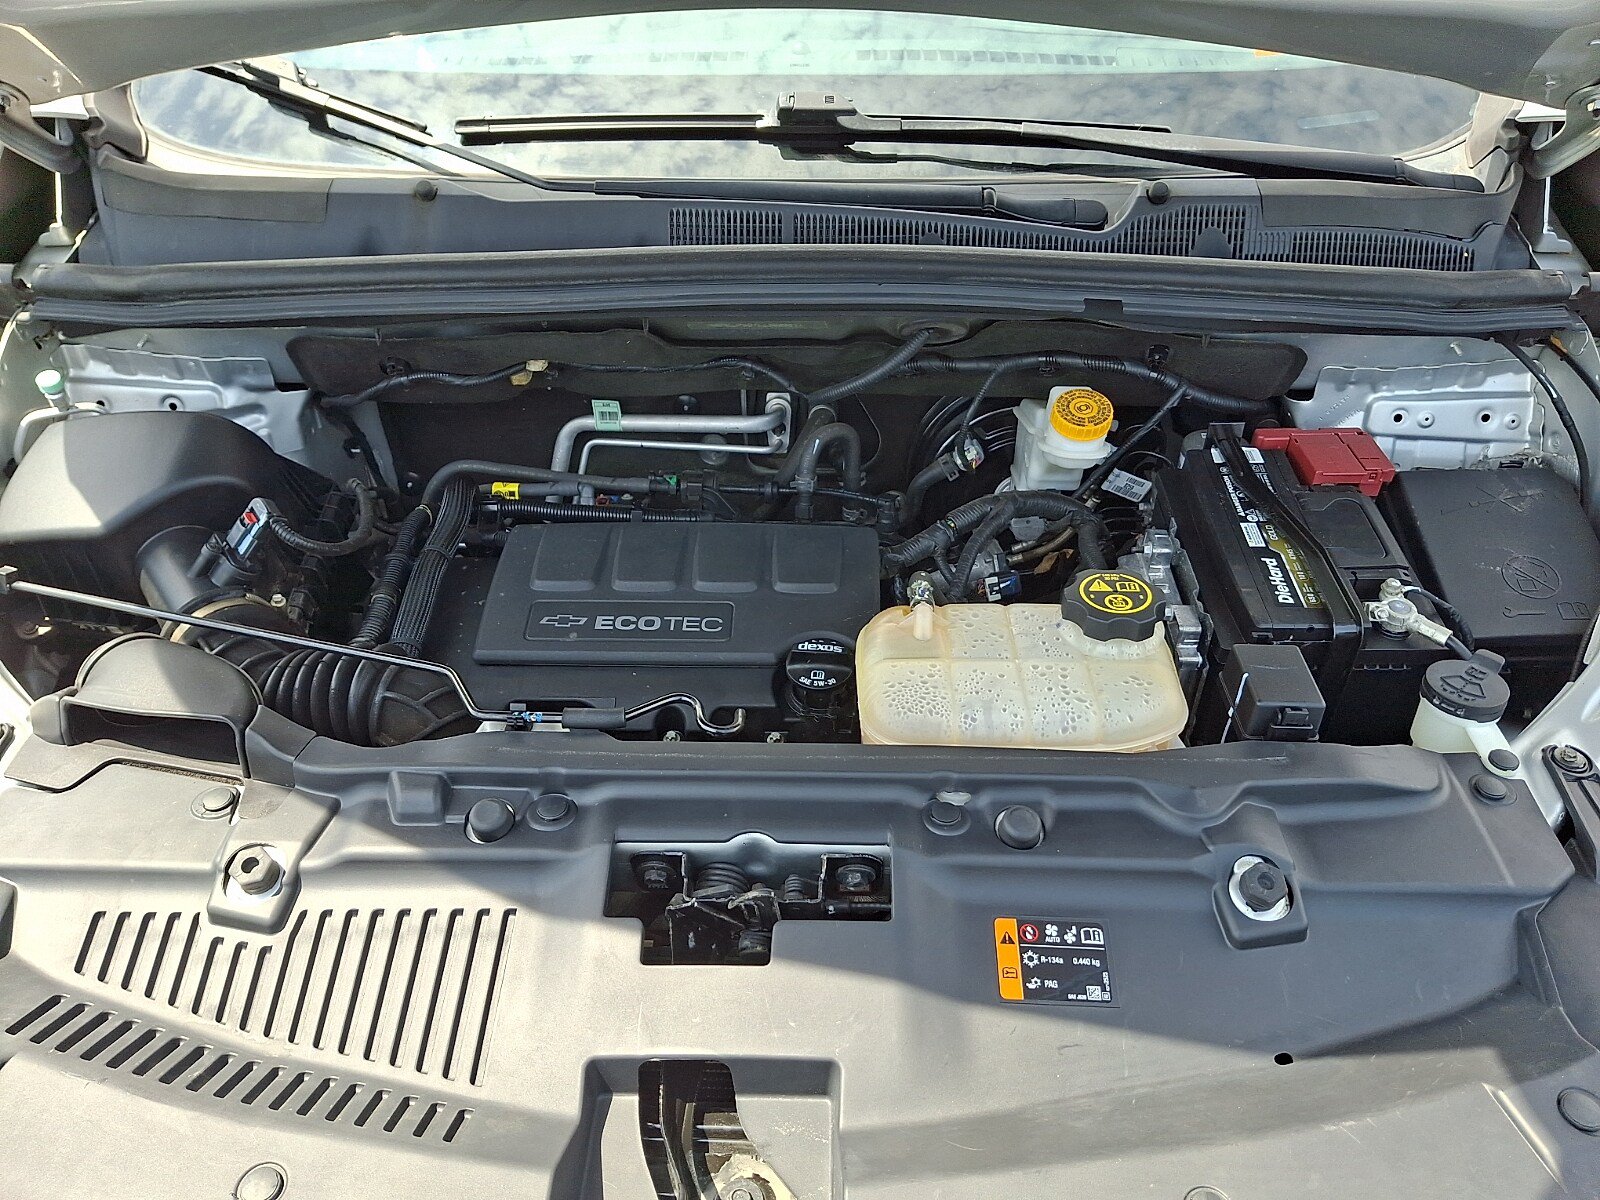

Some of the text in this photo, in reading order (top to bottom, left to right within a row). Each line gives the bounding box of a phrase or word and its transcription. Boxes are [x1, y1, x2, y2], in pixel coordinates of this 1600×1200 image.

[1222, 475, 1236, 493] POISON
[1265, 524, 1279, 541] GOLD
[1260, 557, 1295, 604] DieHard
[594, 615, 723, 632] ECOTEC
[797, 641, 845, 653] dexos
[799, 676, 837, 687] SAE 5W-30
[1040, 955, 1101, 967] R-134a 0.440 kg
[1044, 979, 1059, 989] PAG
